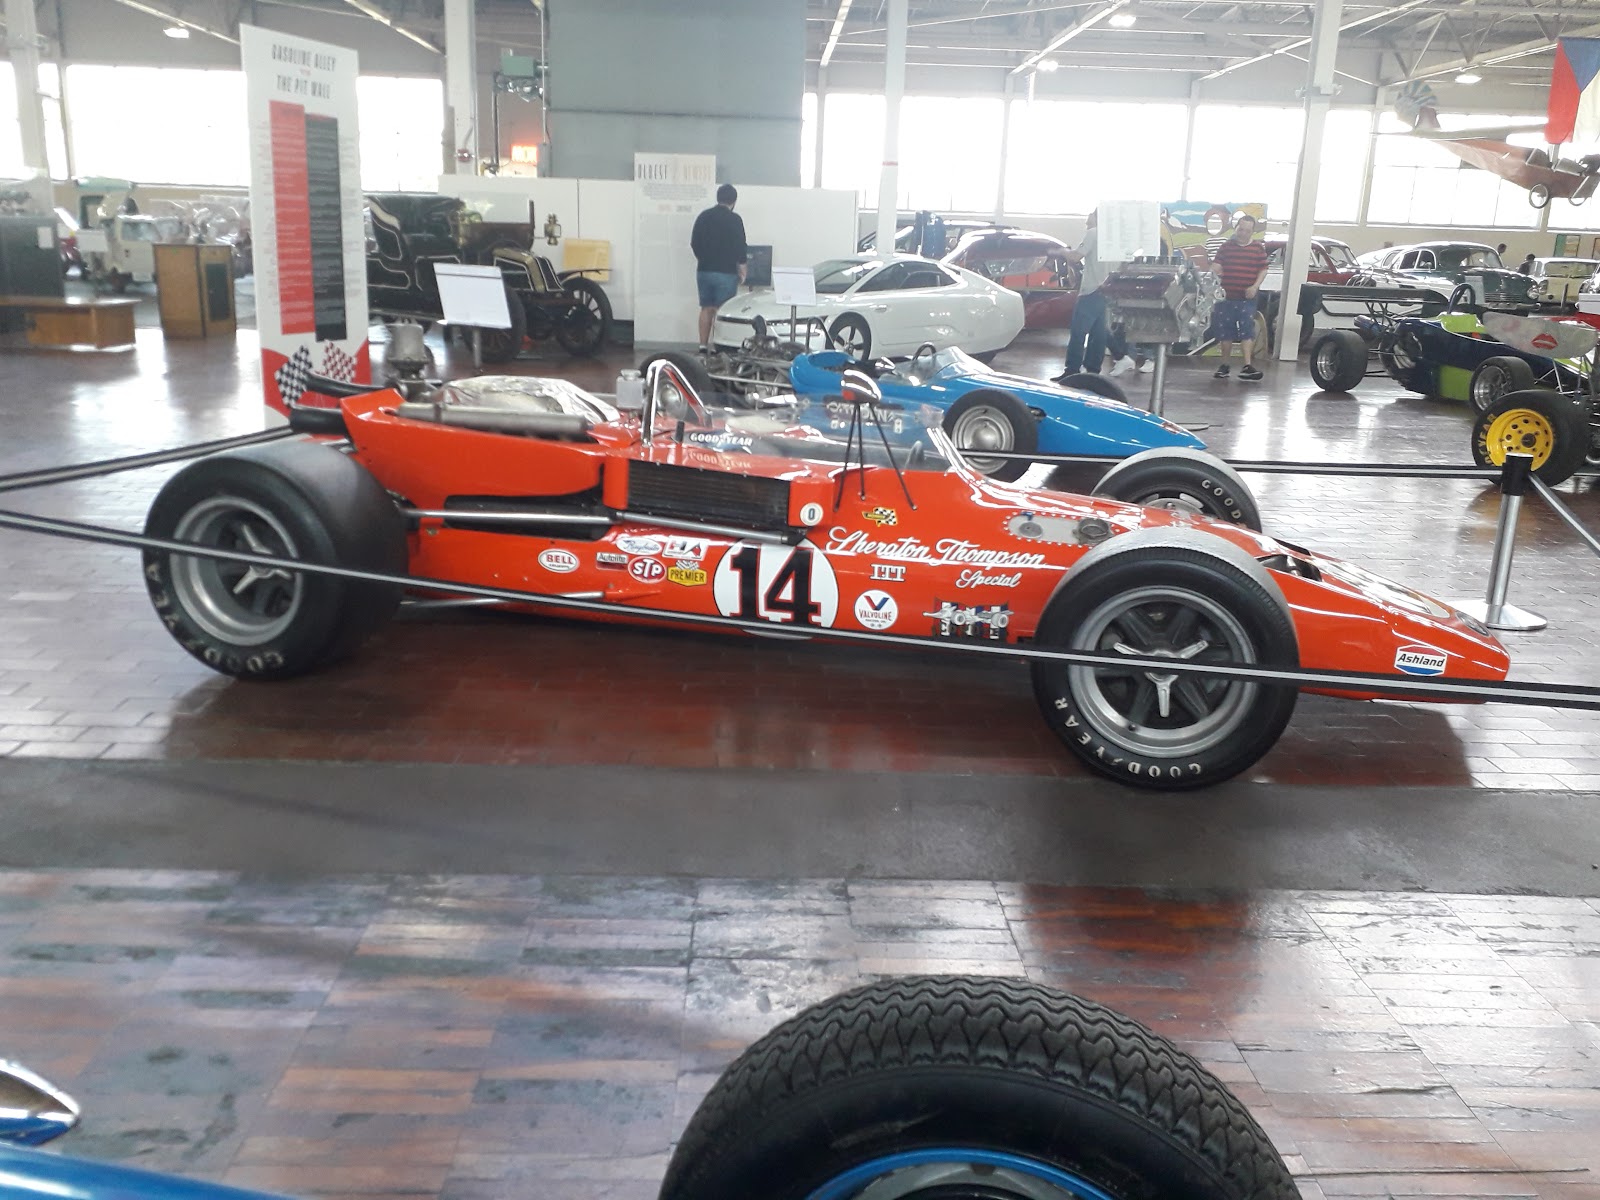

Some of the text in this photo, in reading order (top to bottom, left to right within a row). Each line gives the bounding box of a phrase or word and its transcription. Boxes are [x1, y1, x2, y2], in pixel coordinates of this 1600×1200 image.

[271, 44, 337, 72] GASOLINE ALLEY
[277, 74, 331, 99] THE PIT WALL
[689, 432, 753, 447] GOODYEAR
[1201, 479, 1243, 520] GOOD
[825, 525, 1048, 570] Sheraton Thompson
[546, 554, 574, 565] BELL
[632, 558, 663, 578] STP
[670, 569, 706, 583] PREMIER
[870, 563, 907, 582] ITT
[955, 568, 1023, 589] Special
[728, 544, 822, 625] 14
[858, 608, 892, 621] VALVOLINE
[1397, 652, 1445, 669] Ashland
